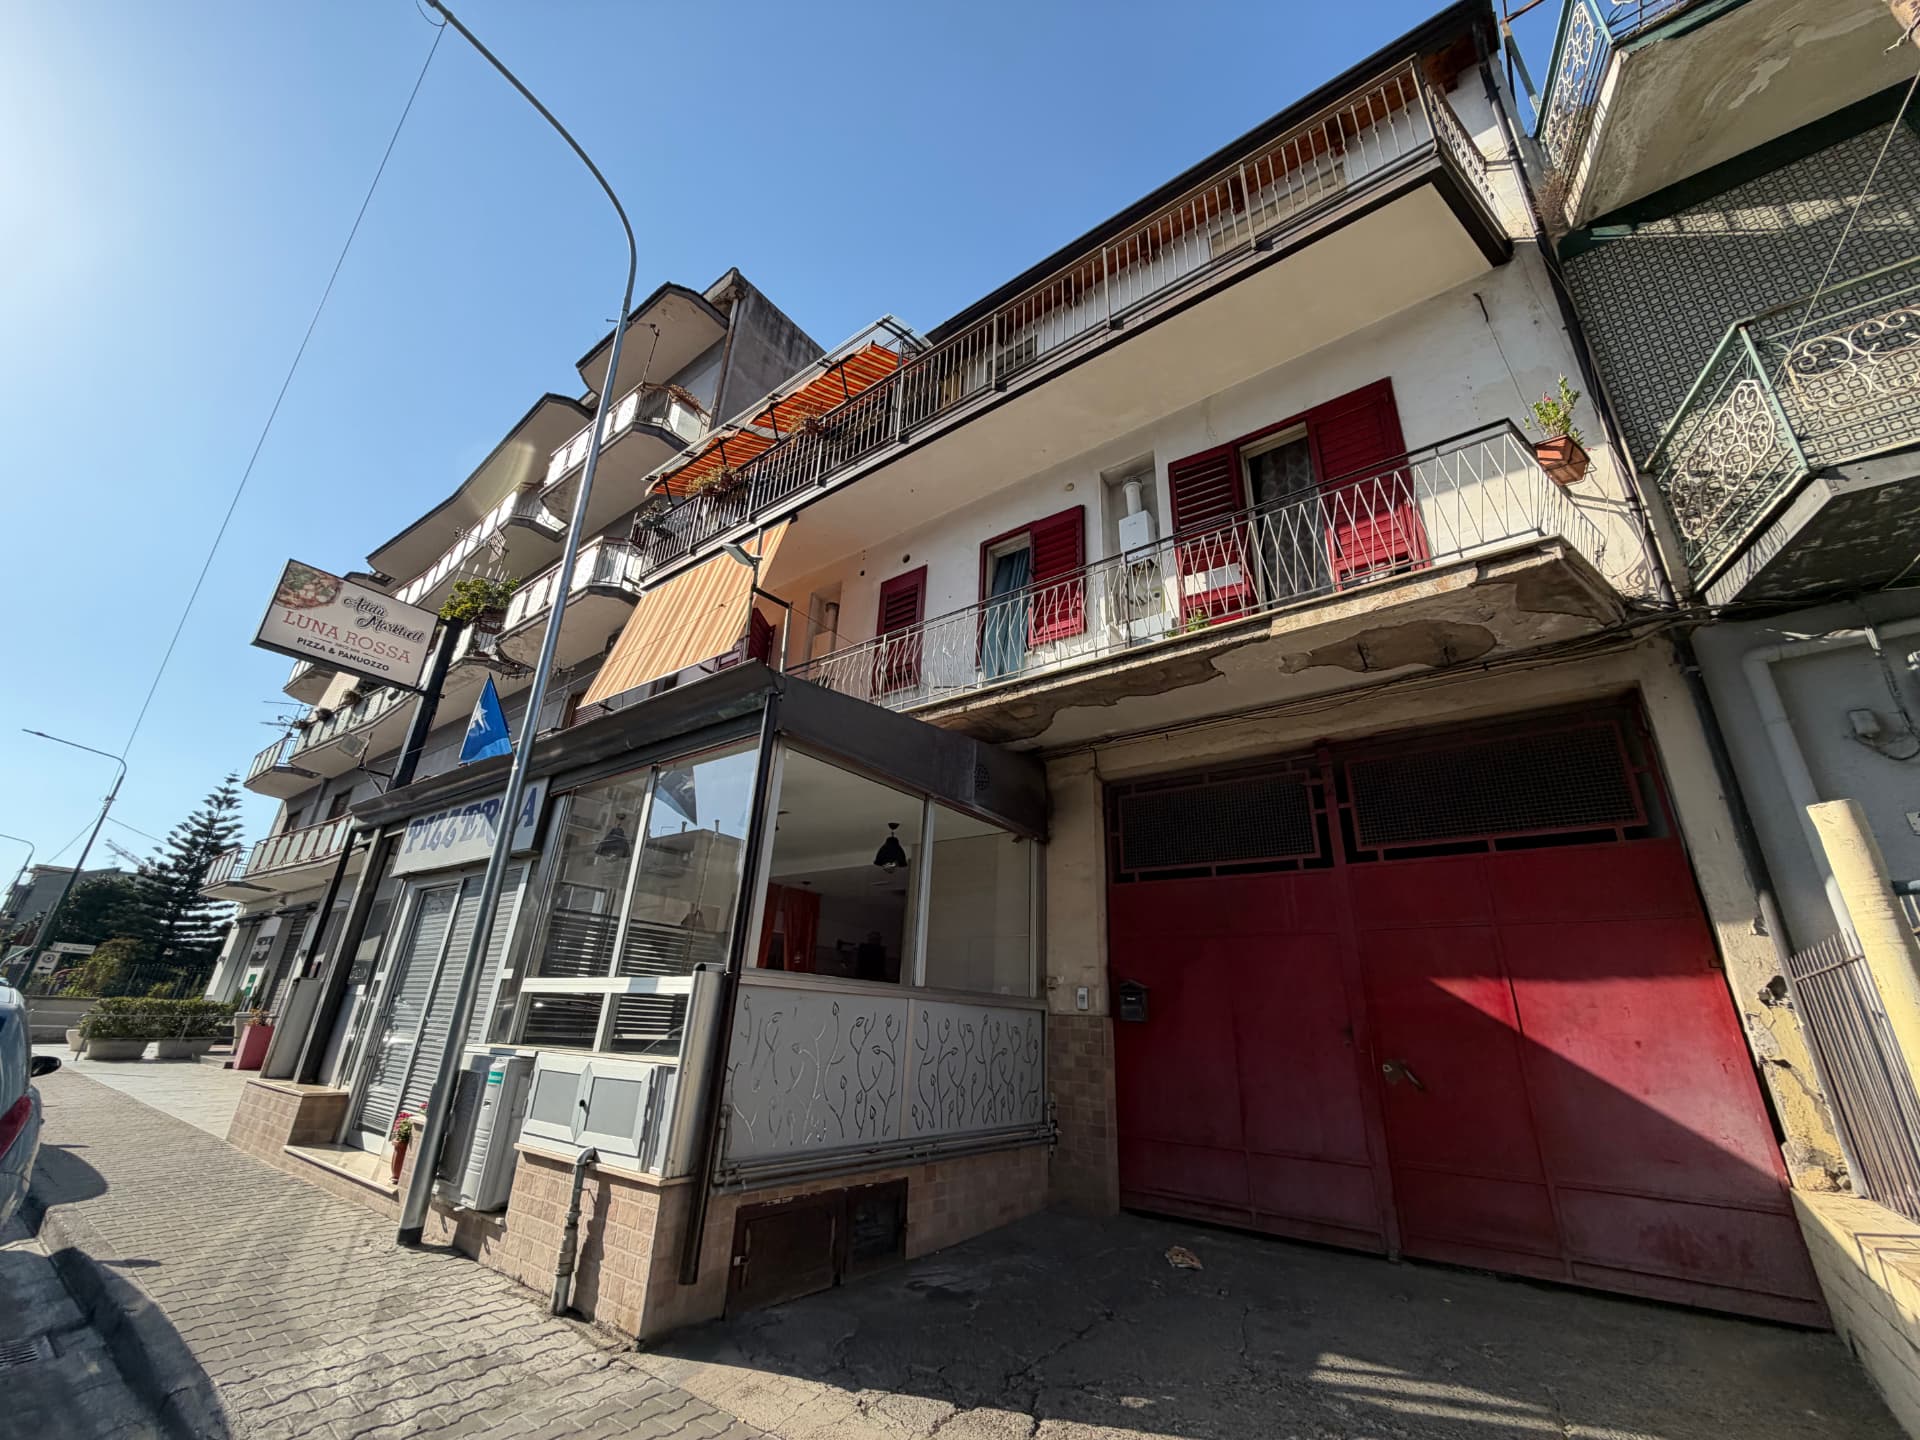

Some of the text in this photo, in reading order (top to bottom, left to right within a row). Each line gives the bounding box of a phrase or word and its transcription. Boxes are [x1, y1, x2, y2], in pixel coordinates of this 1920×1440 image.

[283, 610, 411, 664] LUNA ROSSA
[297, 637, 326, 652] PIZZA
[327, 647, 336, 655] &
[338, 650, 390, 672] PANUOZZO
[404, 787, 538, 854] PIZZERA
